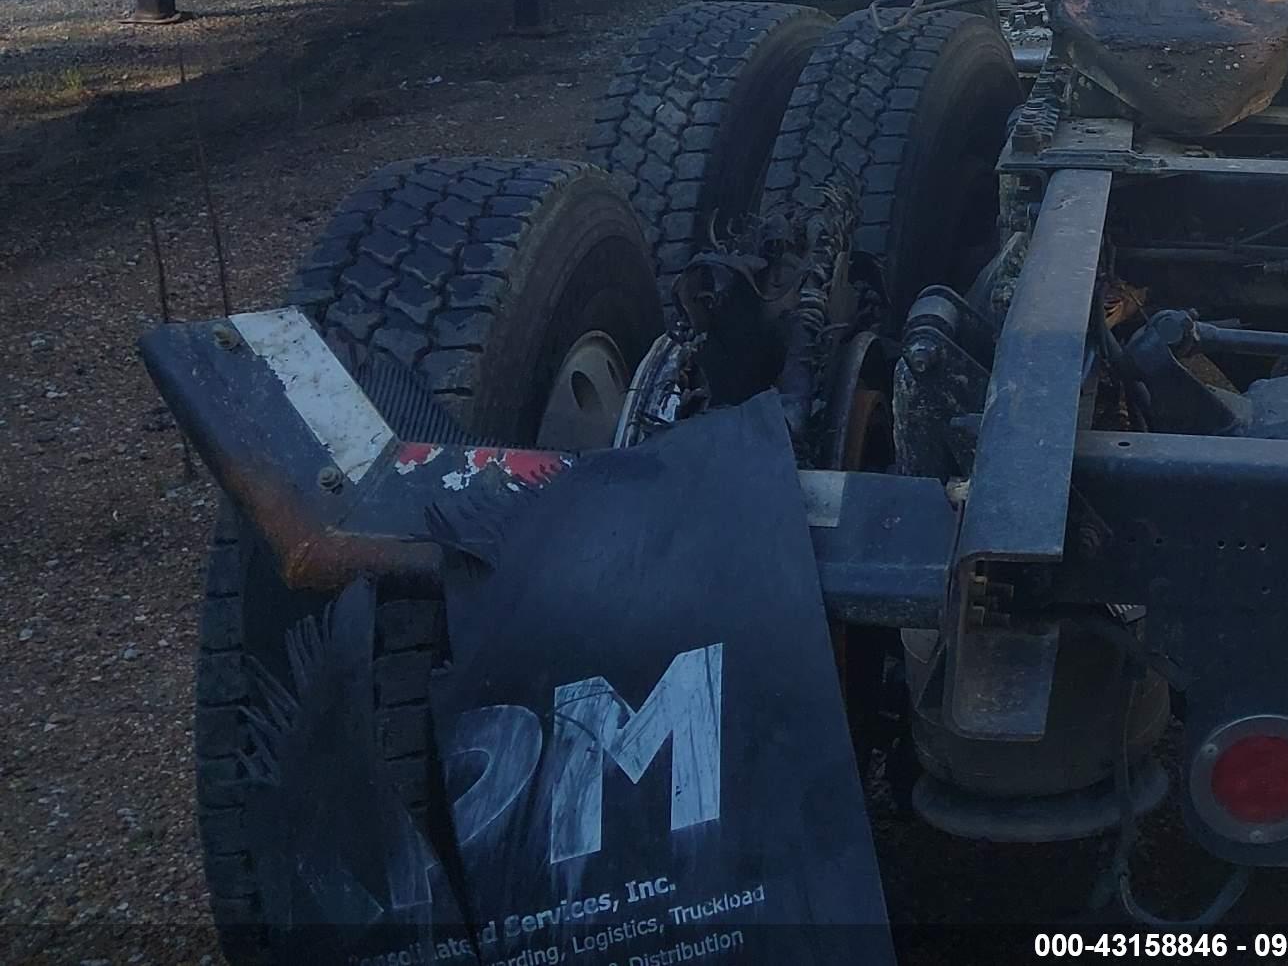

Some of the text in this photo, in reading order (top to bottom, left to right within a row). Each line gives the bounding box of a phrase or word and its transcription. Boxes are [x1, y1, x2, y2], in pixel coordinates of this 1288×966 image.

[503, 891, 619, 938] Services,
[625, 875, 677, 903] Inc.
[571, 918, 665, 954] Logistics,
[668, 884, 766, 925] Truckload
